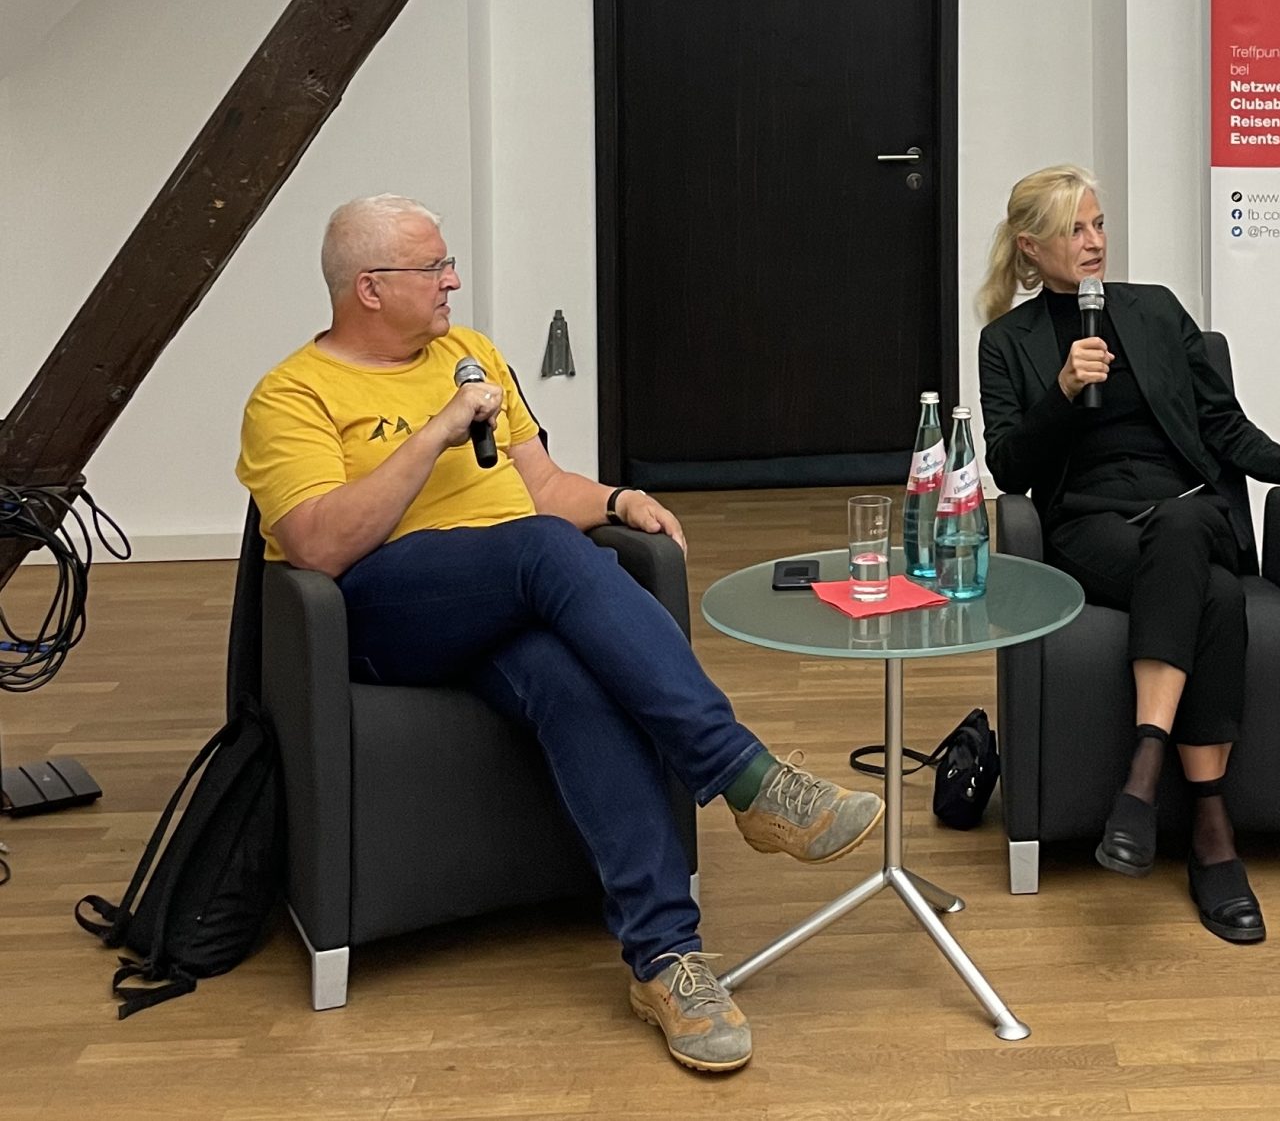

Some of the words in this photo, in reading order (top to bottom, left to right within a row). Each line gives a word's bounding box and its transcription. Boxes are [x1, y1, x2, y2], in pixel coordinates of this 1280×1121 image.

[1230, 64, 1250, 76] bei
[1230, 115, 1280, 128] Reisen
[1230, 133, 1280, 145] Events
